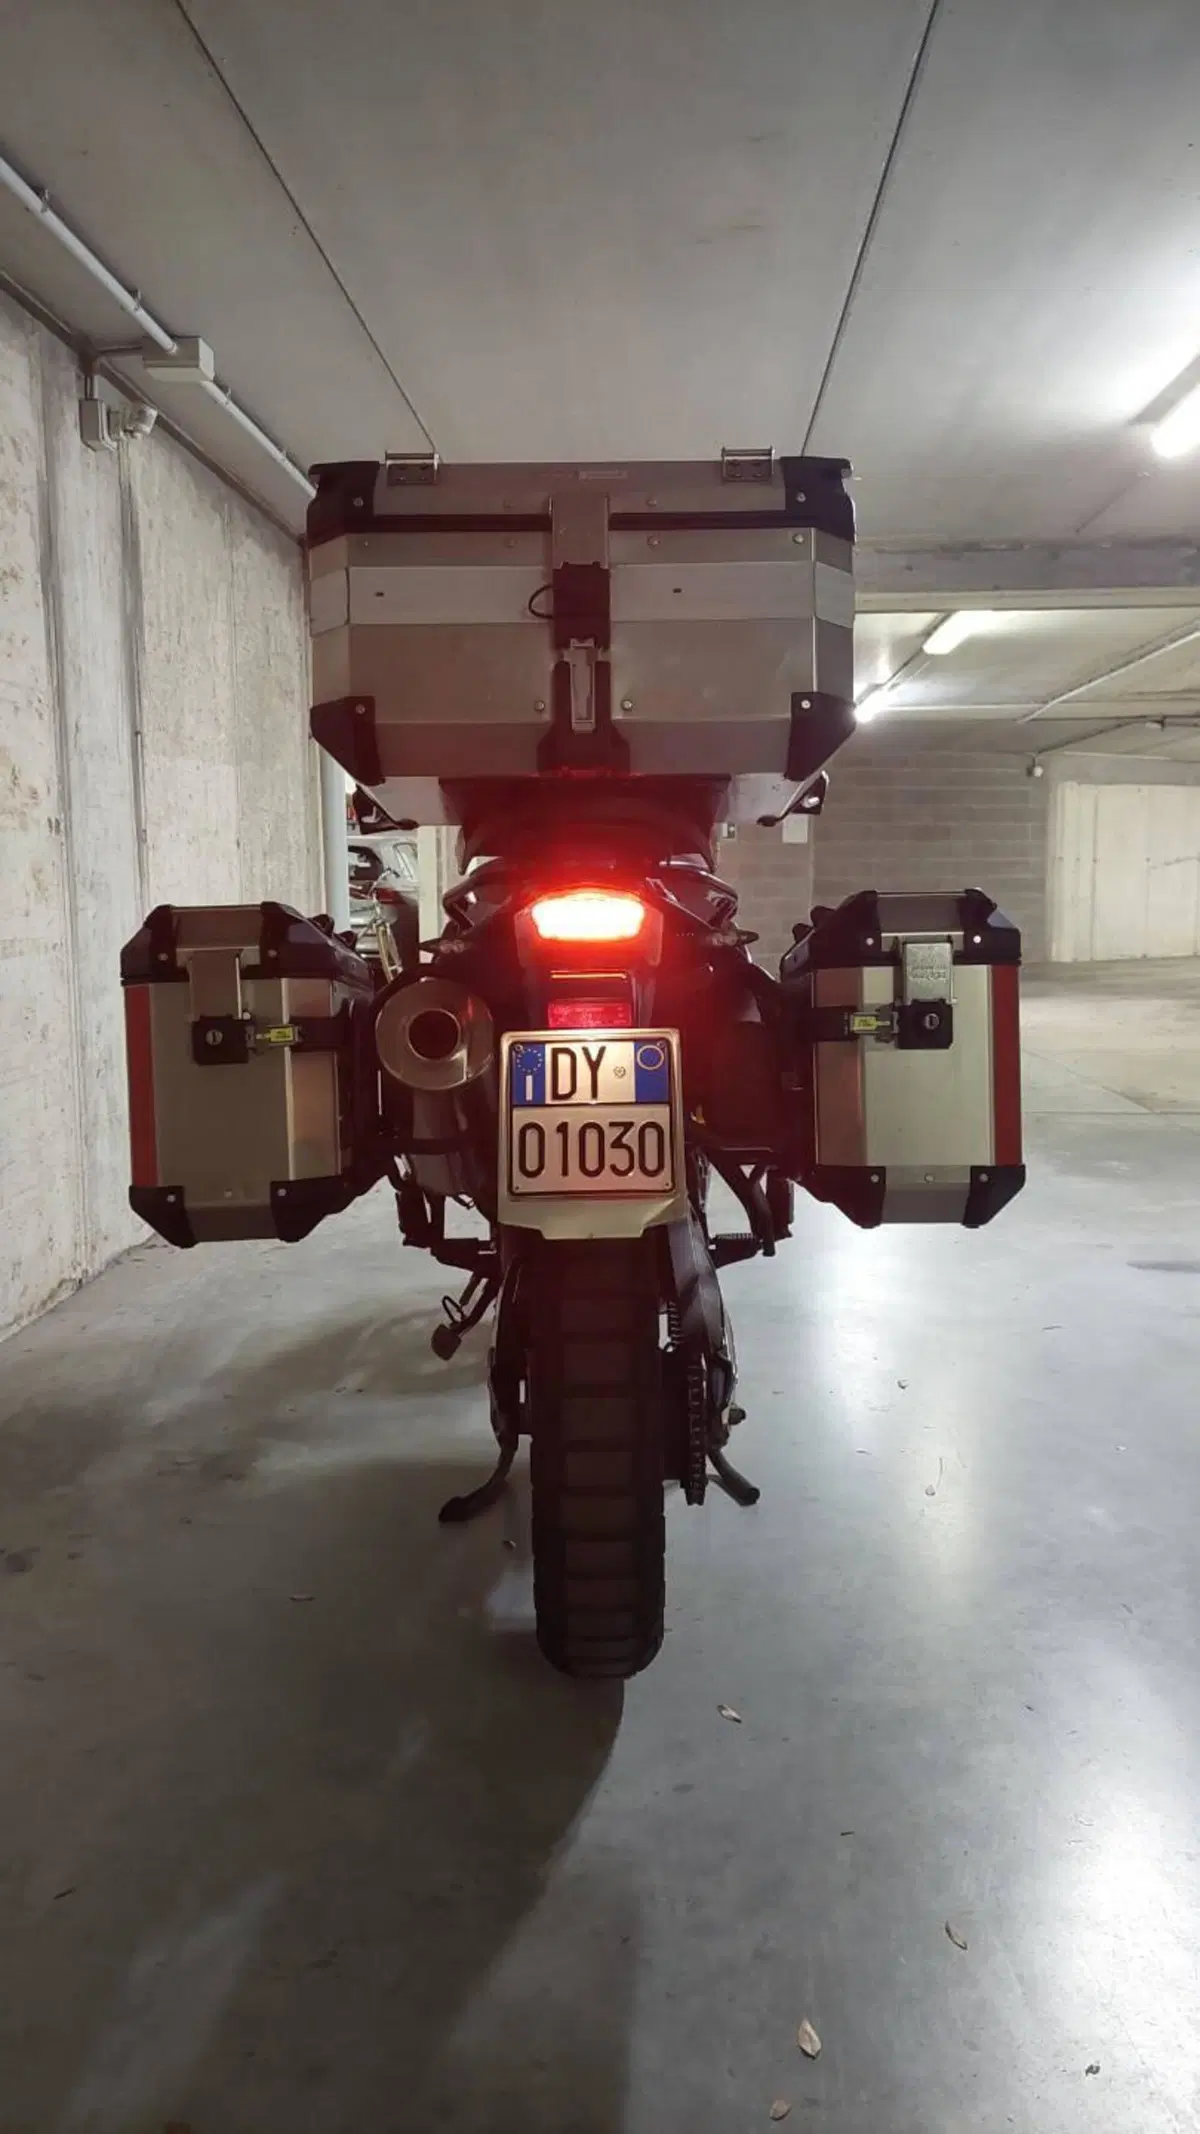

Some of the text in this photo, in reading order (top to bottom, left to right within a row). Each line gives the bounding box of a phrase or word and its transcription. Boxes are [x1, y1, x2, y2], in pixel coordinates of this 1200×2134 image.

[525, 1074, 533, 1101] I
[551, 1046, 606, 1100] DY
[518, 1121, 665, 1178] 01030
